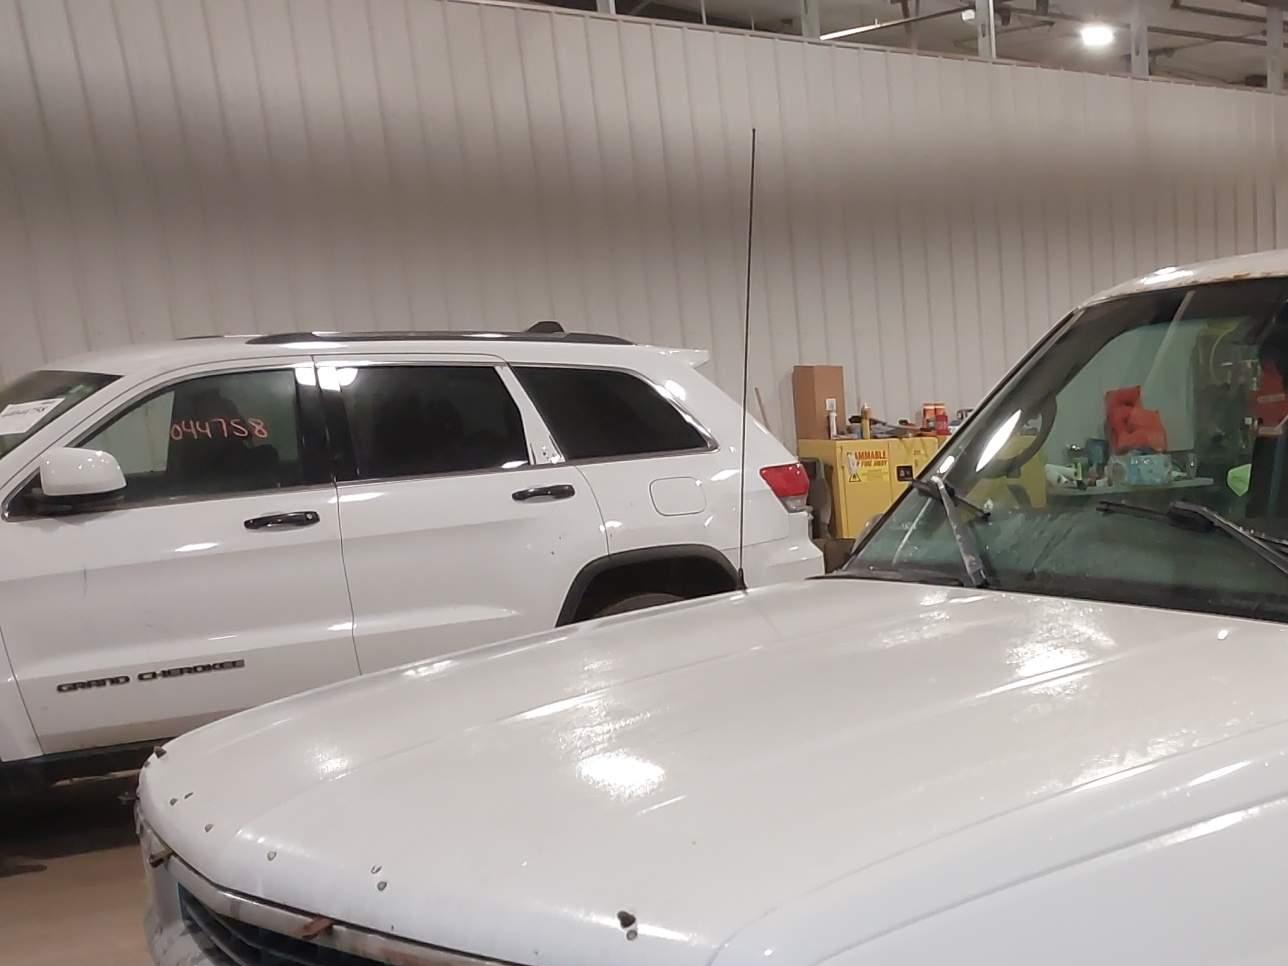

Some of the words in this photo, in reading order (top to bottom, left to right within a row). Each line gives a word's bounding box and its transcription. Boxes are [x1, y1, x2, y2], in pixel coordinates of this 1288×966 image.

[171, 417, 268, 440] 044758
[56, 675, 131, 693] GRAND
[137, 658, 246, 681] CHEROKEE
